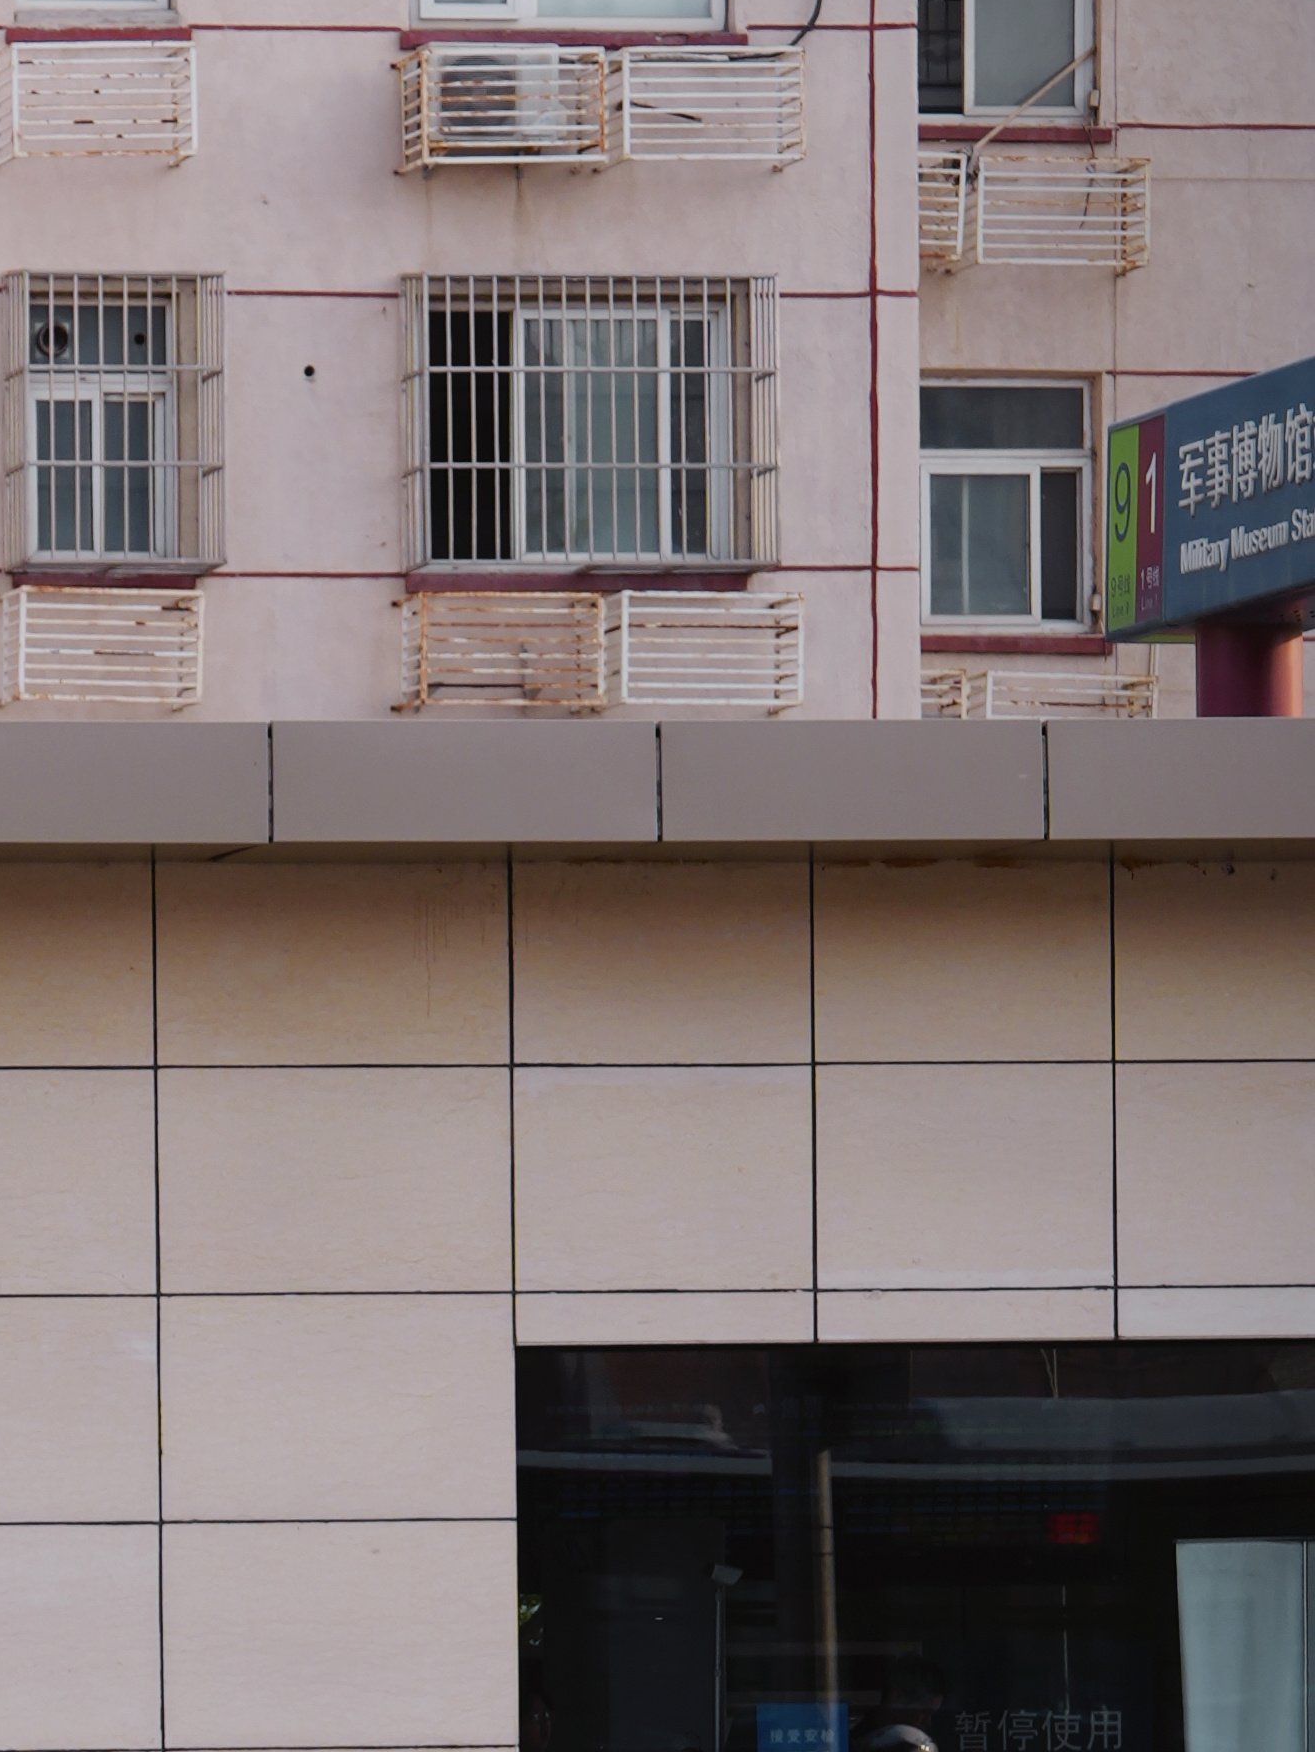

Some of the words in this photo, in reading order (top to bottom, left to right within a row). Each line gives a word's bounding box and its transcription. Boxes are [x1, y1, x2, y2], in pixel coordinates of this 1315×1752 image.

[1145, 452, 1158, 534] 1
[1178, 403, 1315, 518] 军事博物馆
[1114, 462, 1131, 543] 9
[1180, 537, 1229, 574] Military
[1231, 520, 1289, 560] Museum
[1291, 508, 1315, 542] Sta
[1141, 566, 1160, 591] 1号线
[955, 1709, 1123, 1752] 暂停使用
